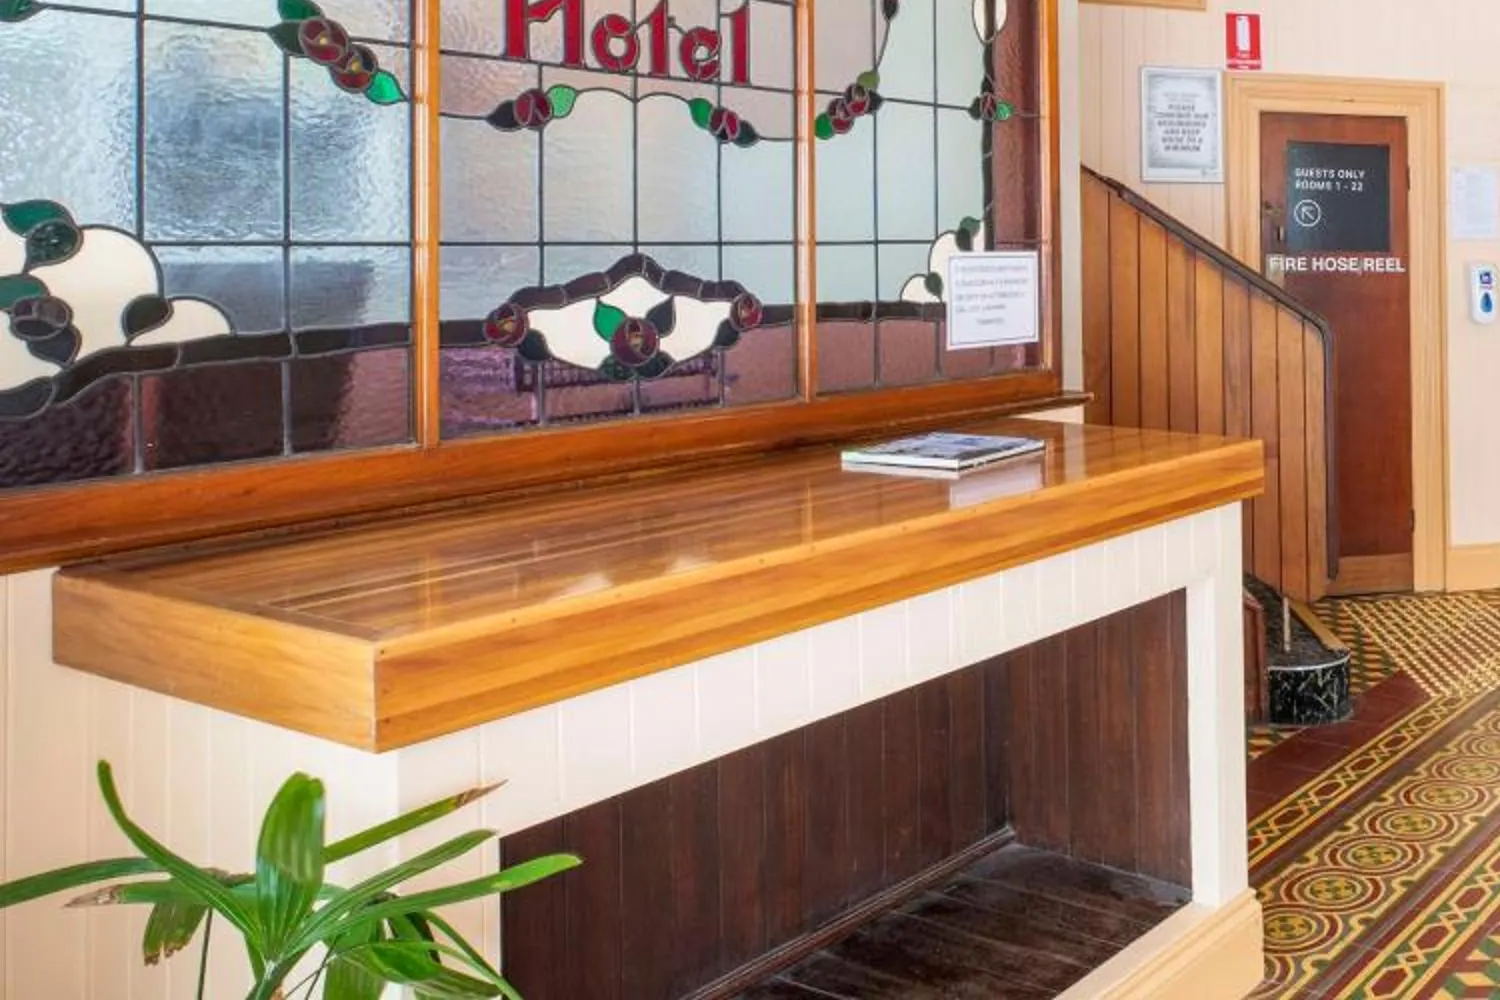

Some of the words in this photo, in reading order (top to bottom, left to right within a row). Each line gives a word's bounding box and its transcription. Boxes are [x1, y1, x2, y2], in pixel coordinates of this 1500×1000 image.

[1295, 168, 1335, 179] GUESTS
[1338, 169, 1365, 179] ONLY
[1295, 179, 1332, 191] ROOMS
[1269, 257, 1308, 272] FIRE
[1312, 257, 1359, 272] HOSE
[1364, 257, 1406, 272] REEL
